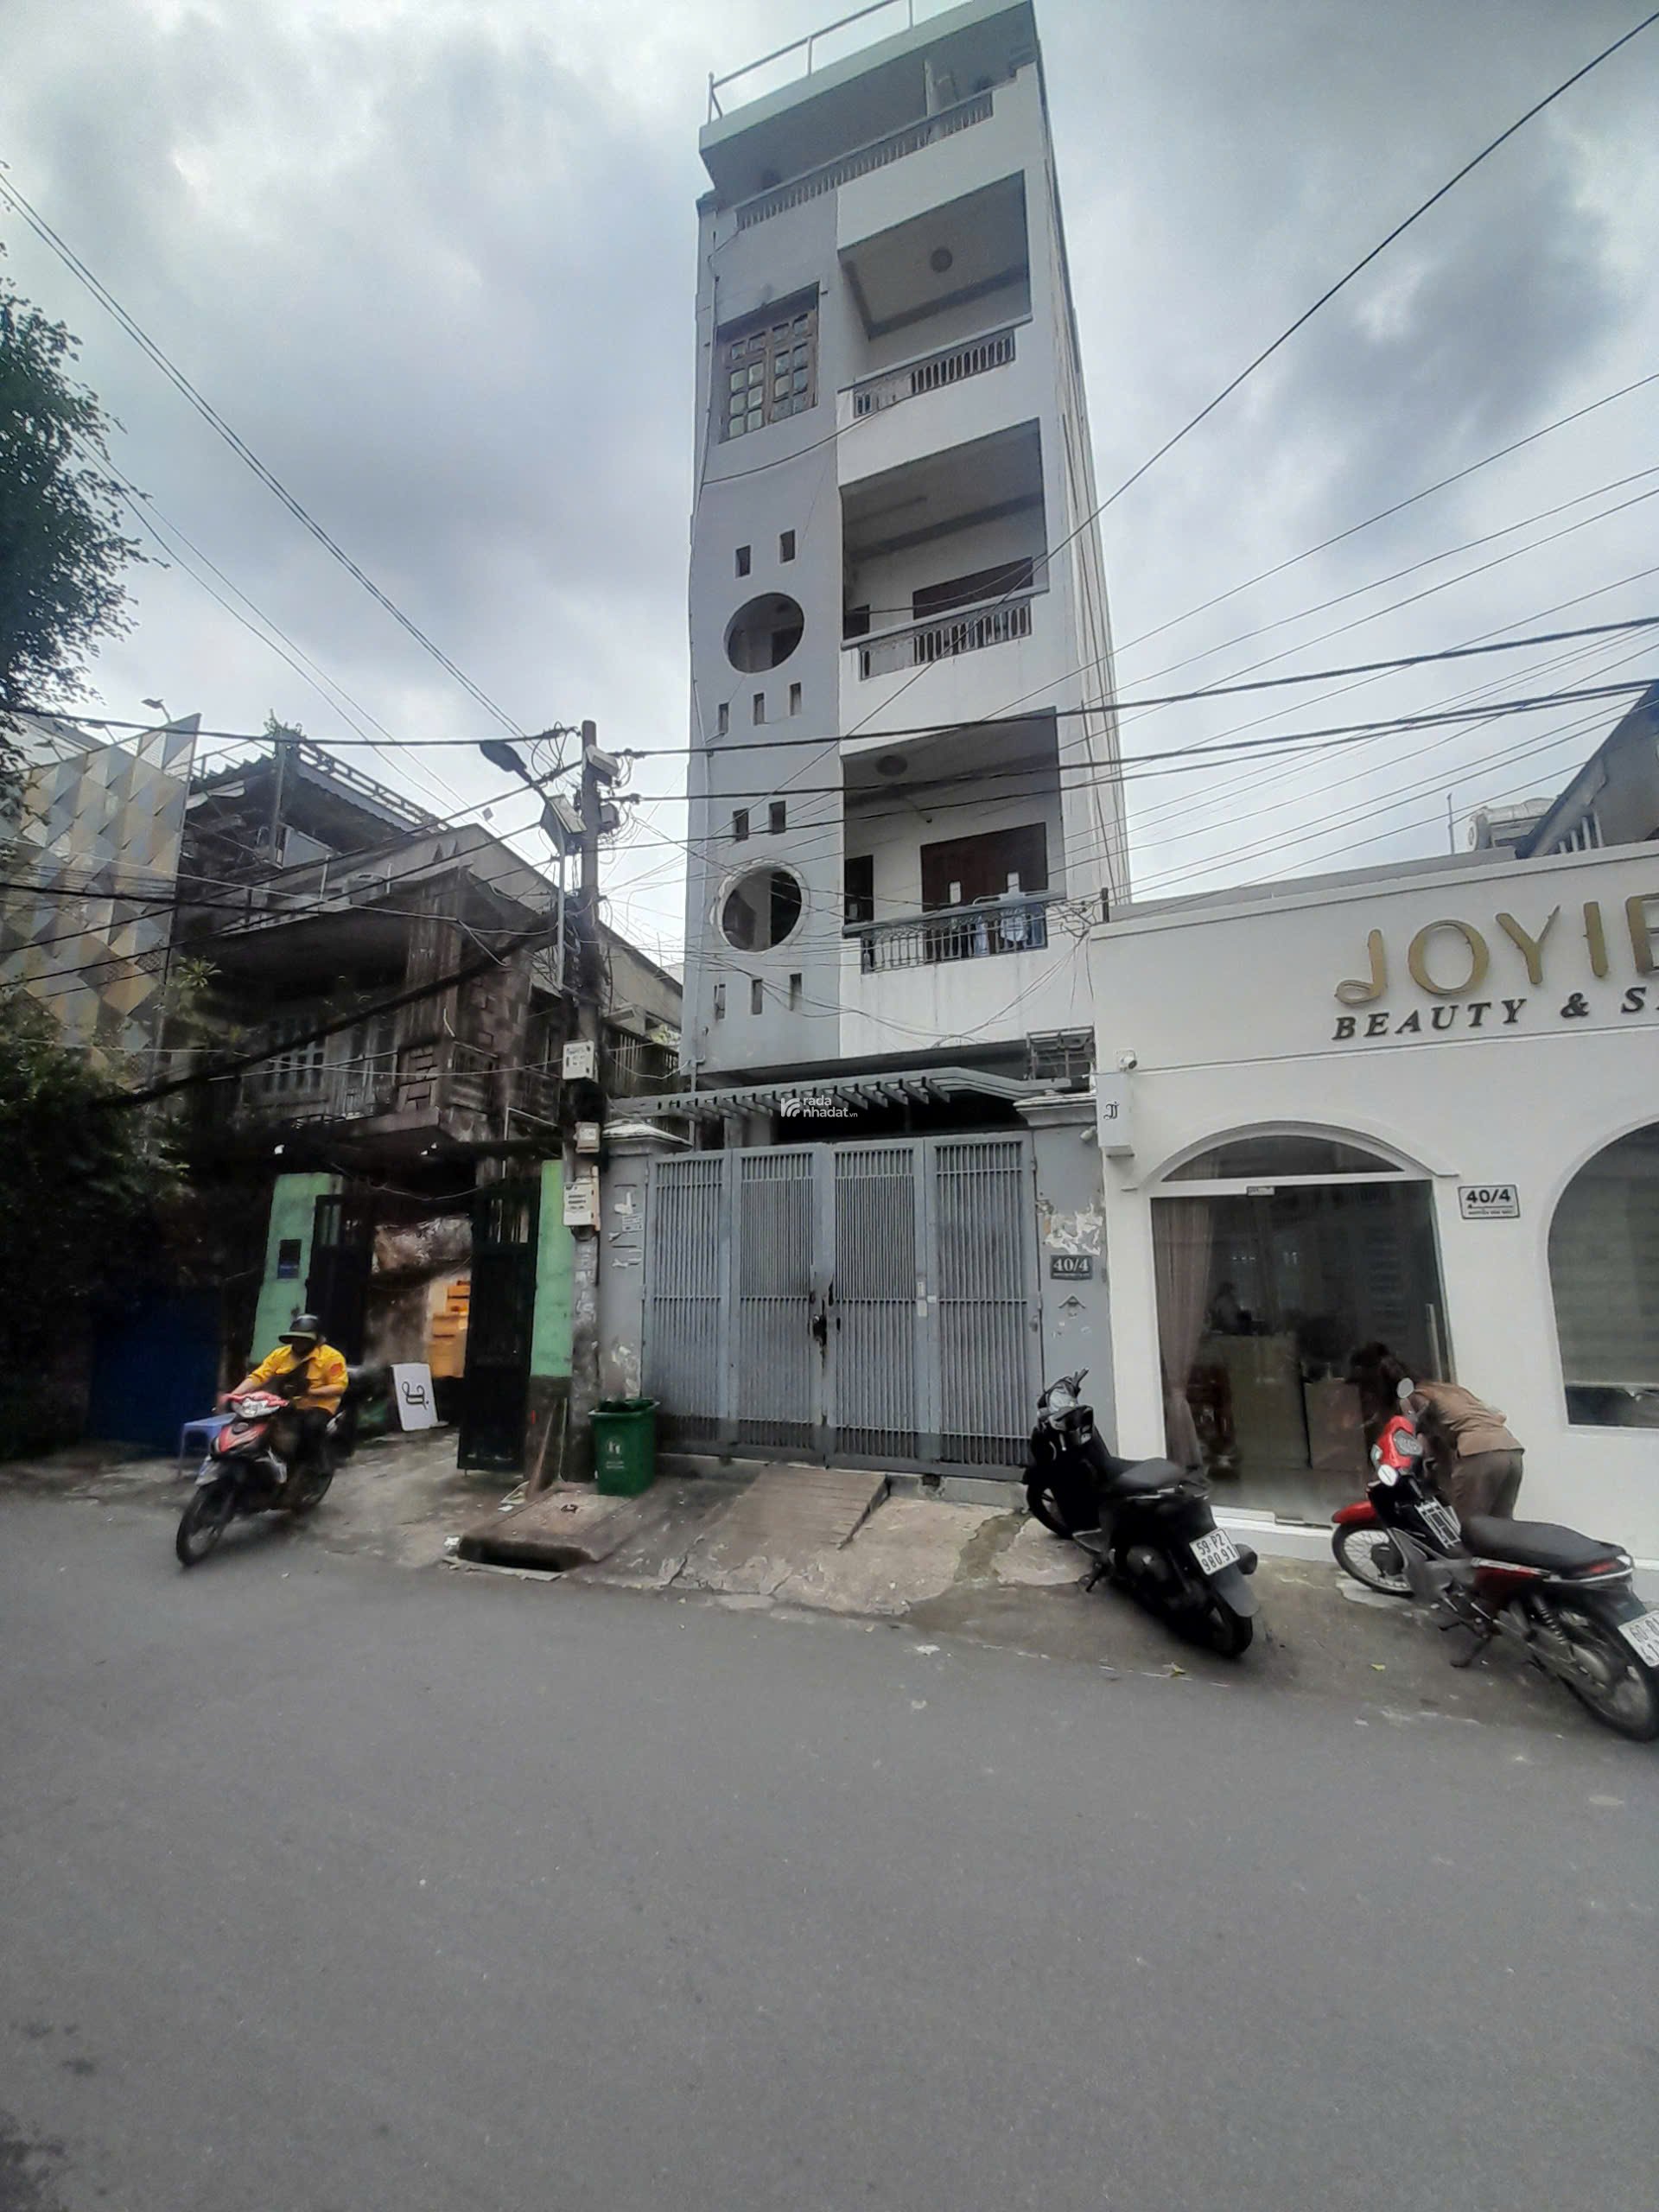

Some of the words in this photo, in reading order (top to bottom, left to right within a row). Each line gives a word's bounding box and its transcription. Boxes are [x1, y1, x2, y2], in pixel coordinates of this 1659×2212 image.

[1332, 998, 1527, 1039] BEAUTY
[1560, 992, 1589, 1018] &
[1621, 987, 1659, 1014] S
[1465, 1189, 1511, 1203] 40/4
[1053, 1258, 1089, 1271] 40/4
[1196, 1533, 1225, 1555] 59-P2
[1201, 1546, 1236, 1571] 980.91
